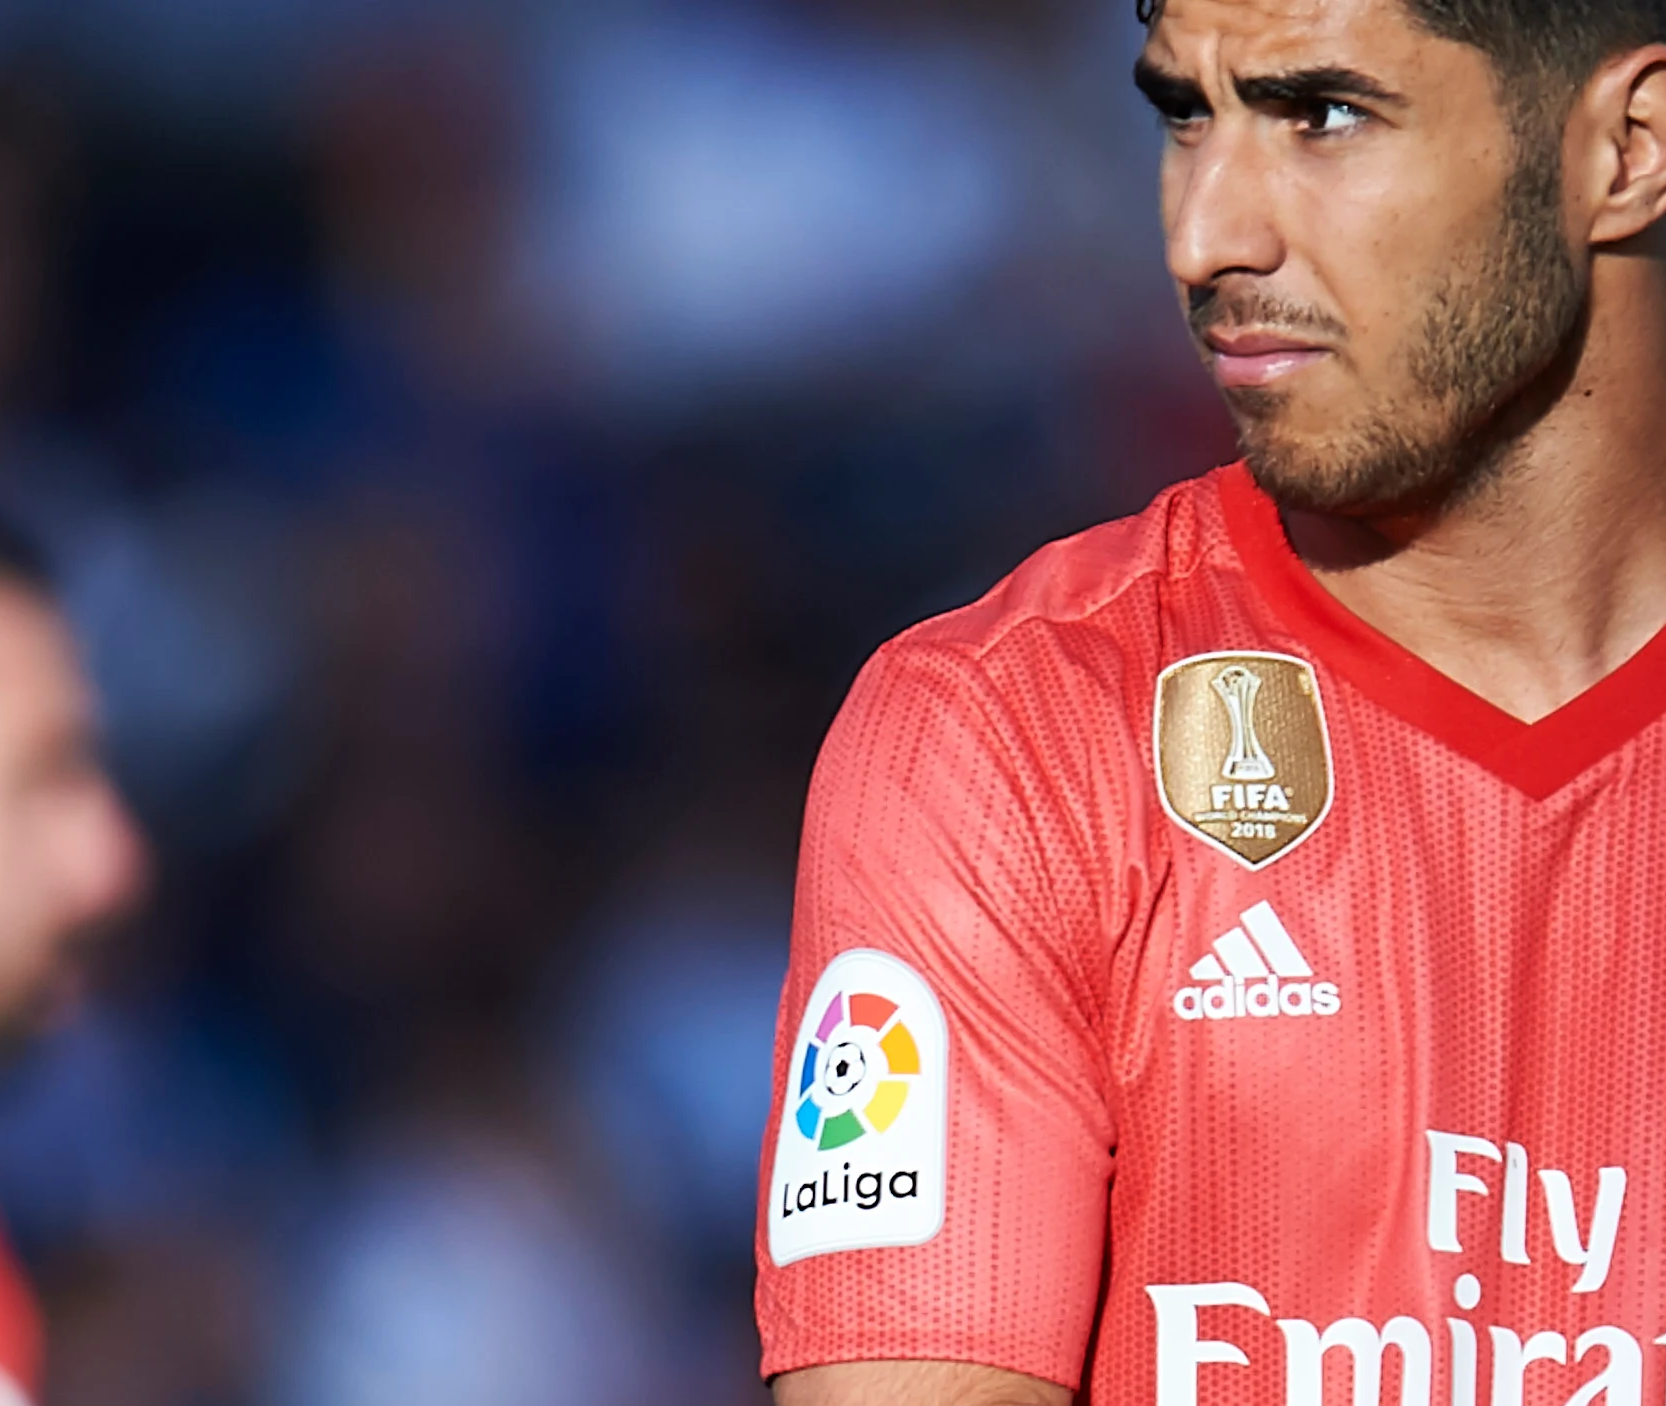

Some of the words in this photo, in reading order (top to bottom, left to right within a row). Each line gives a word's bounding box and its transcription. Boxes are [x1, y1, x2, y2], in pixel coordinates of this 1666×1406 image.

[1210, 783, 1290, 811] FIFA
[1230, 822, 1277, 840] 2018
[1173, 974, 1342, 1020] adidas
[782, 1161, 919, 1219] LaLiga
[1424, 1128, 1627, 1294] Fly
